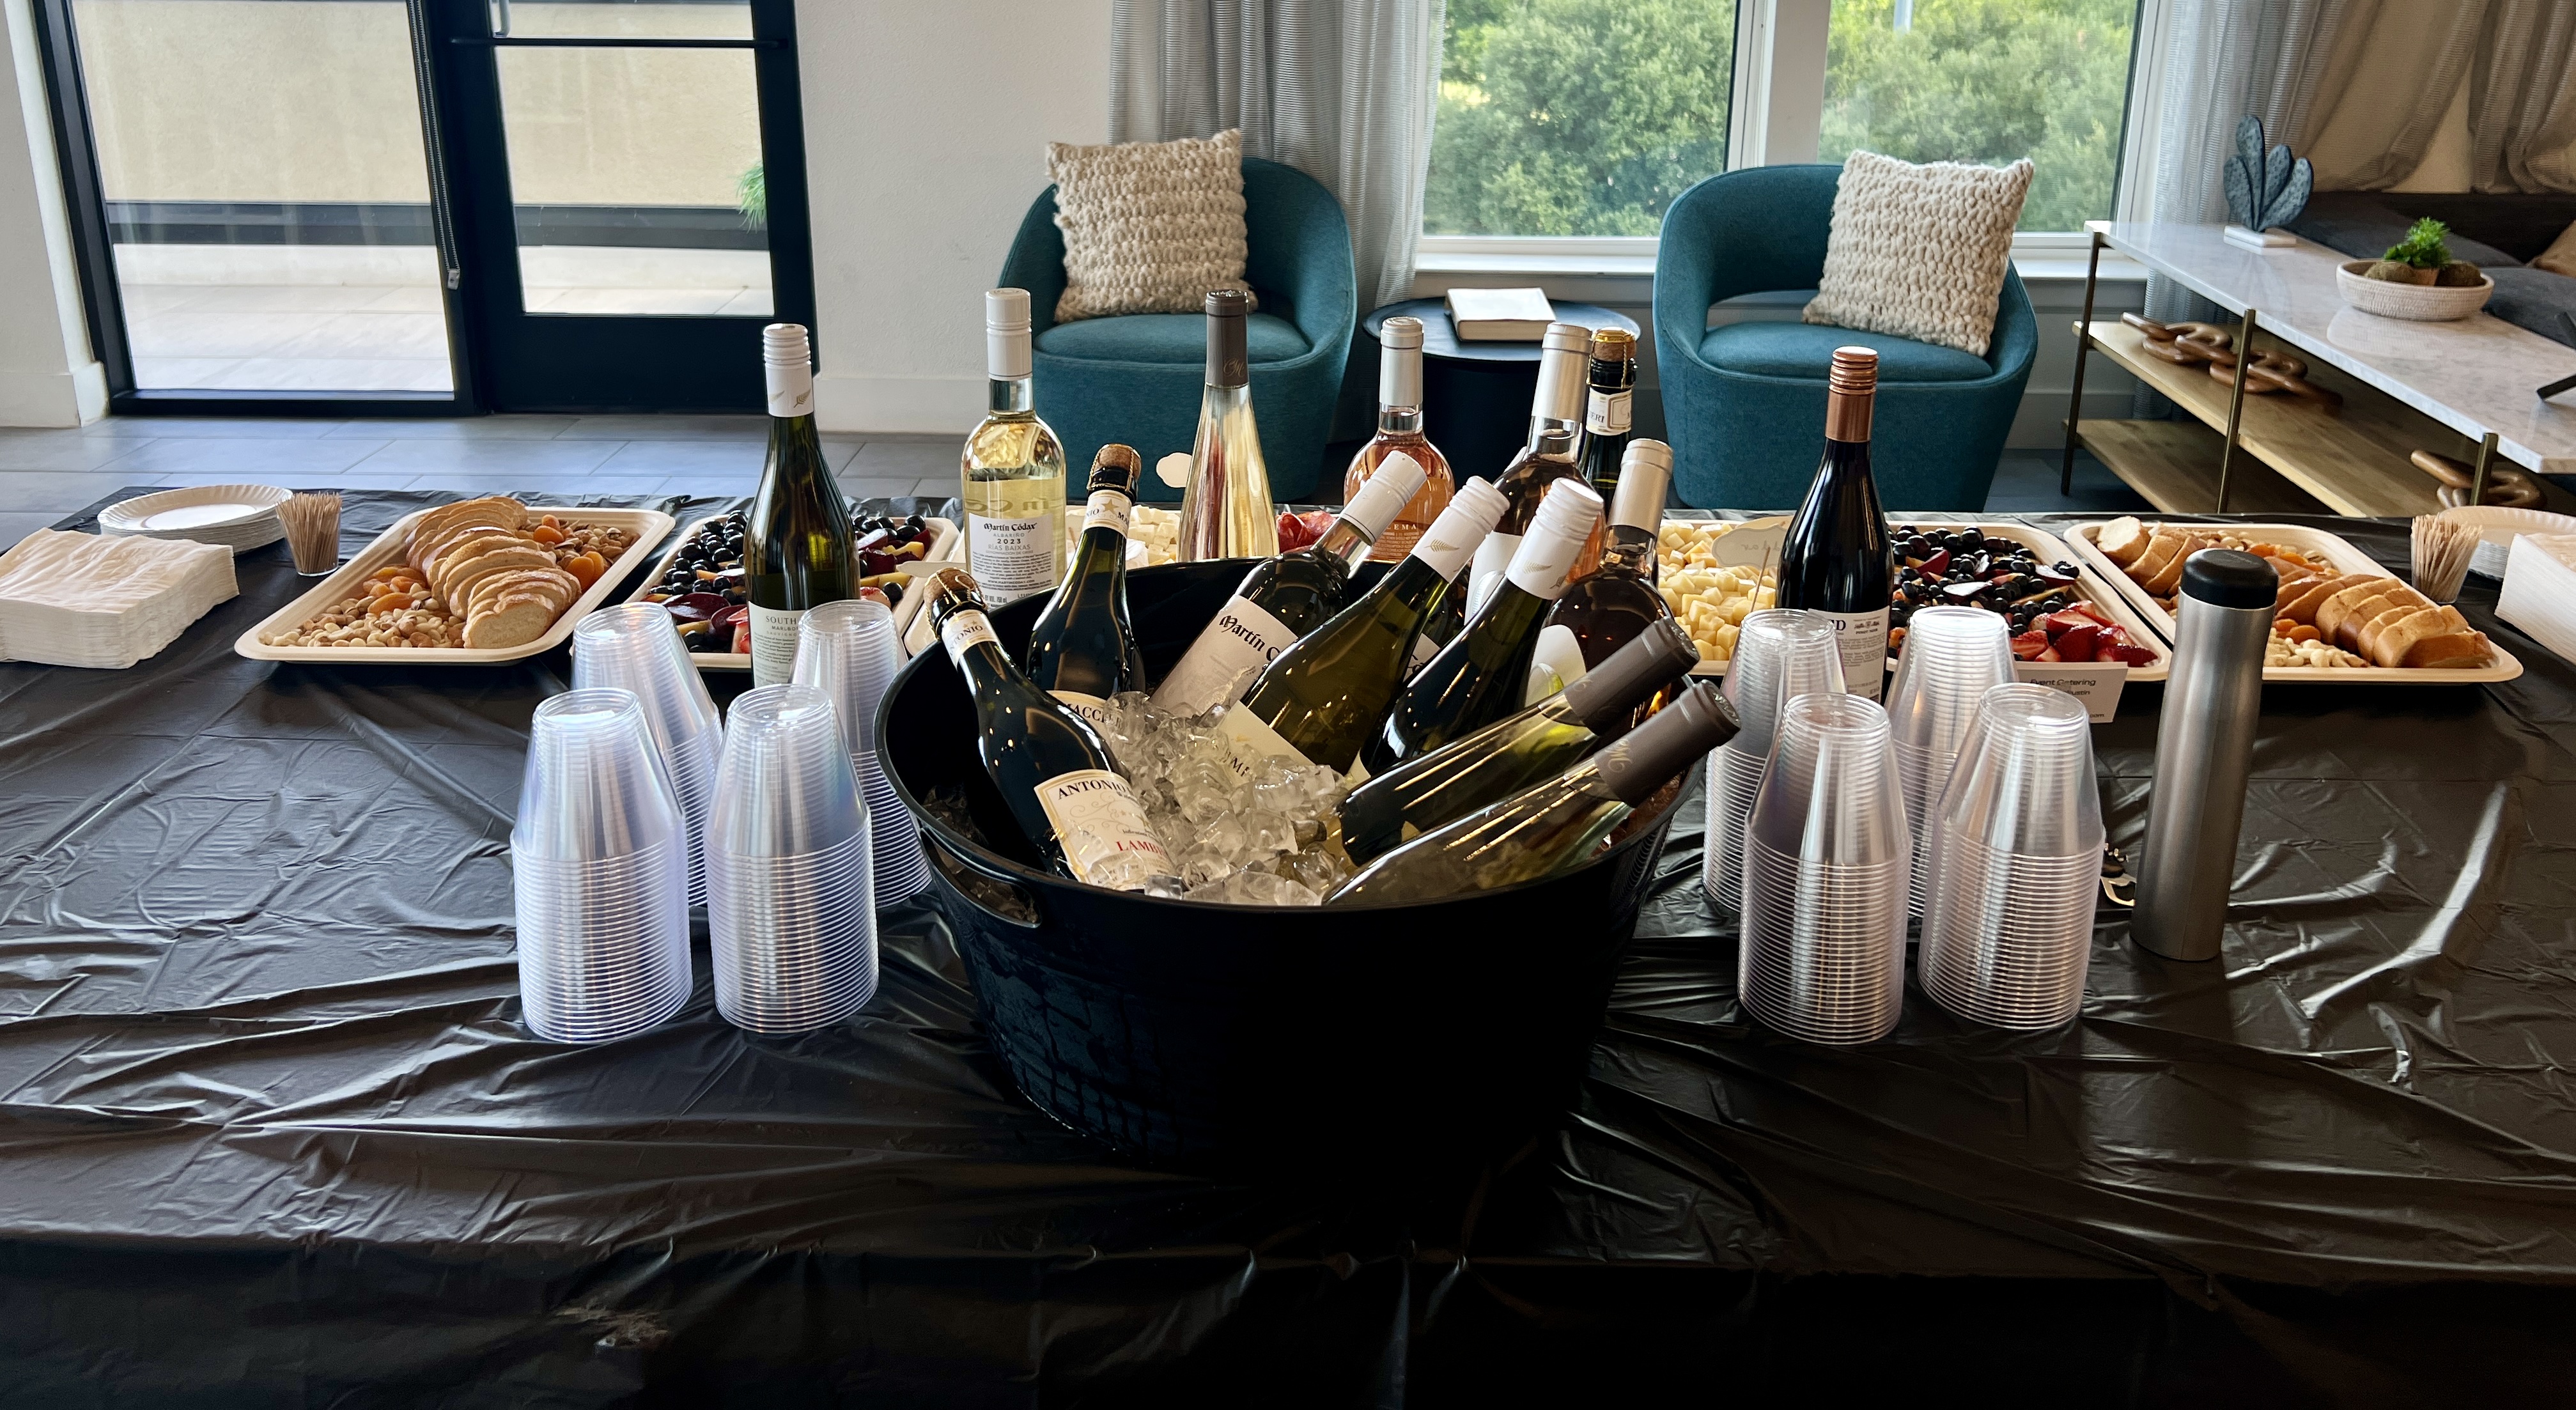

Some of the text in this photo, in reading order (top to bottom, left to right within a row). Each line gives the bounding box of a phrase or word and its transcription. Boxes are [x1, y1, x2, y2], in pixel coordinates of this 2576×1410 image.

[984, 523, 1037, 533] Martín Códax
[1219, 615, 1266, 652] Martín
[1058, 779, 1127, 800] ANTONIO
